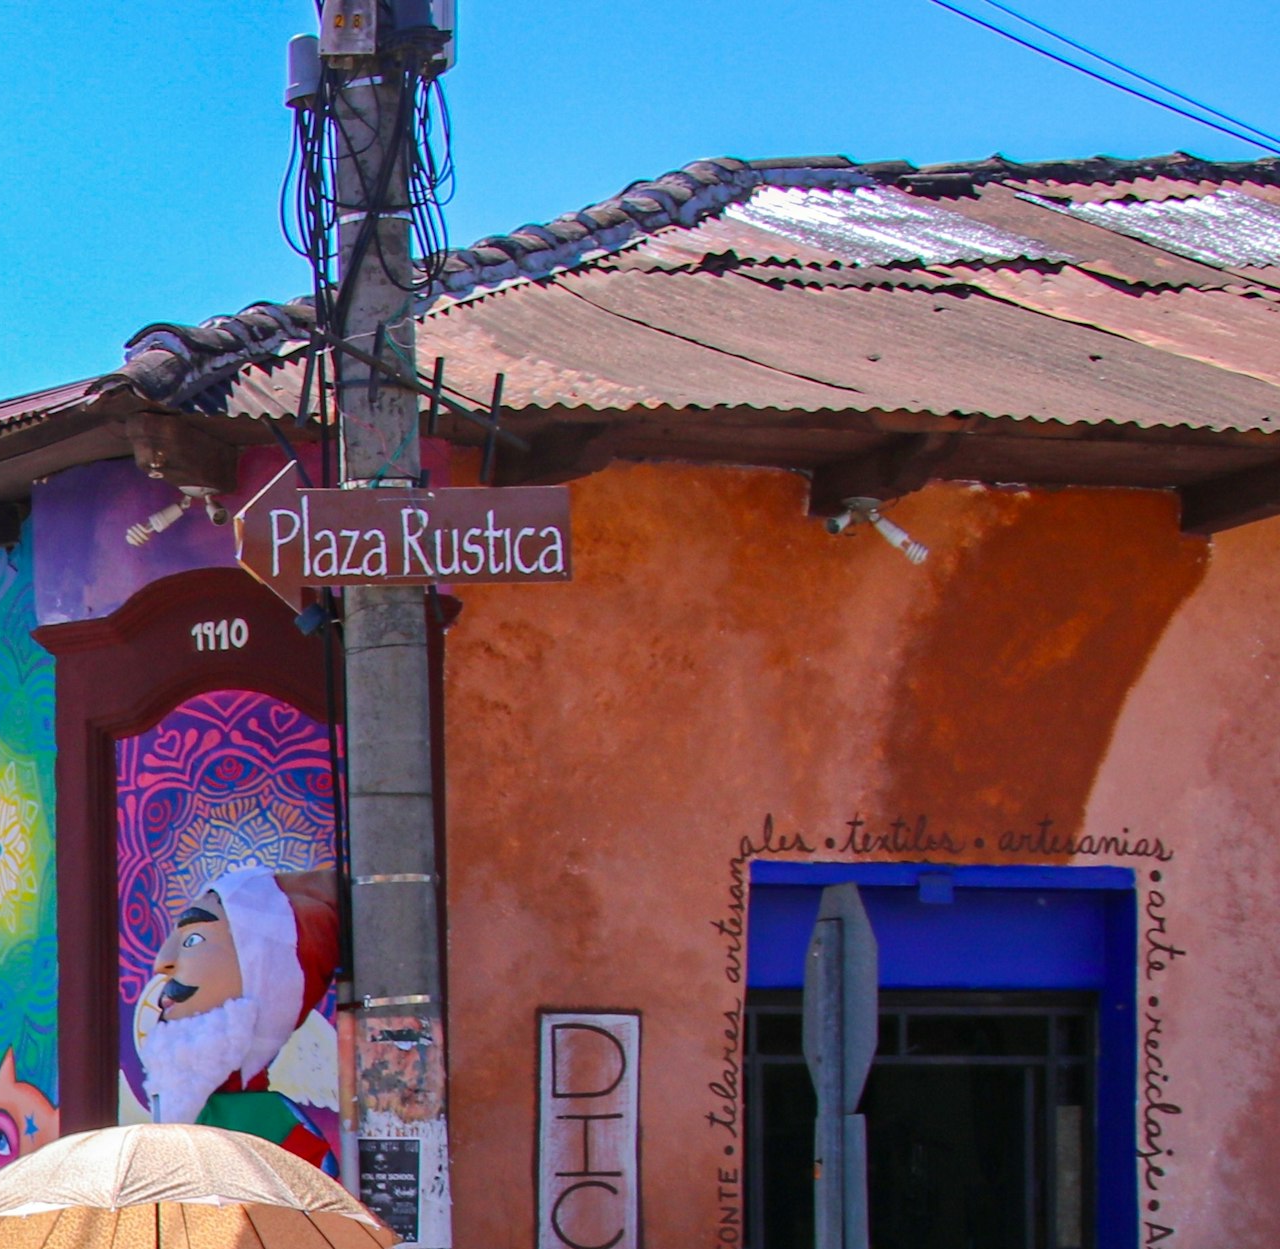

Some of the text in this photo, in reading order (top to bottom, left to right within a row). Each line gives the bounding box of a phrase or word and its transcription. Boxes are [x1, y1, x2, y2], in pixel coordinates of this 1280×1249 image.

[269, 495, 567, 577] Plaza Rustica
[192, 618, 249, 651] 1910
[709, 813, 816, 983] artesanales
[1145, 890, 1187, 981] arte
[704, 998, 741, 1139] telares
[1136, 1011, 1182, 1191] reciclaje
